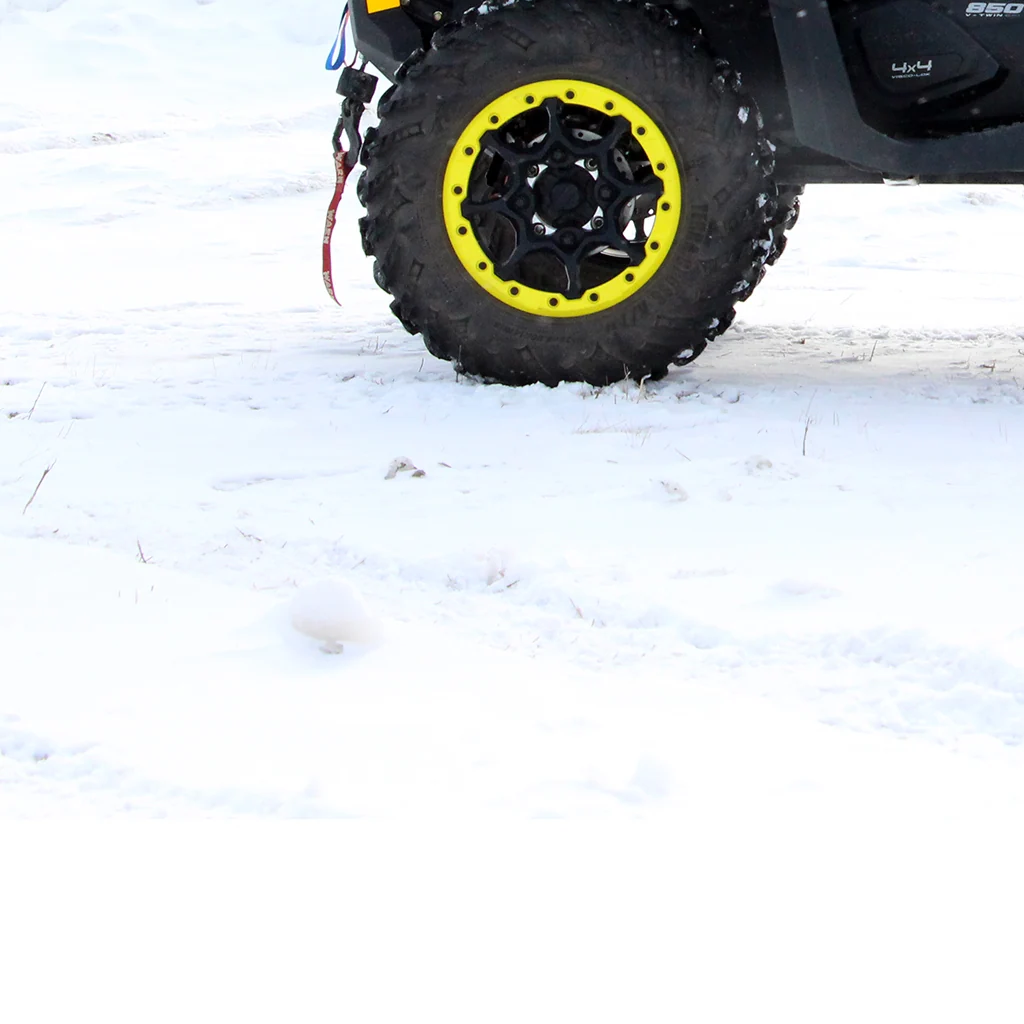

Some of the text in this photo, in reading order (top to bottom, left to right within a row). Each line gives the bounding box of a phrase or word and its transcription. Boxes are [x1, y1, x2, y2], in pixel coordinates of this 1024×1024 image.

[965, 2, 1024, 13] 850
[335, 152, 345, 184] WARN
[323, 209, 335, 245] WARN
